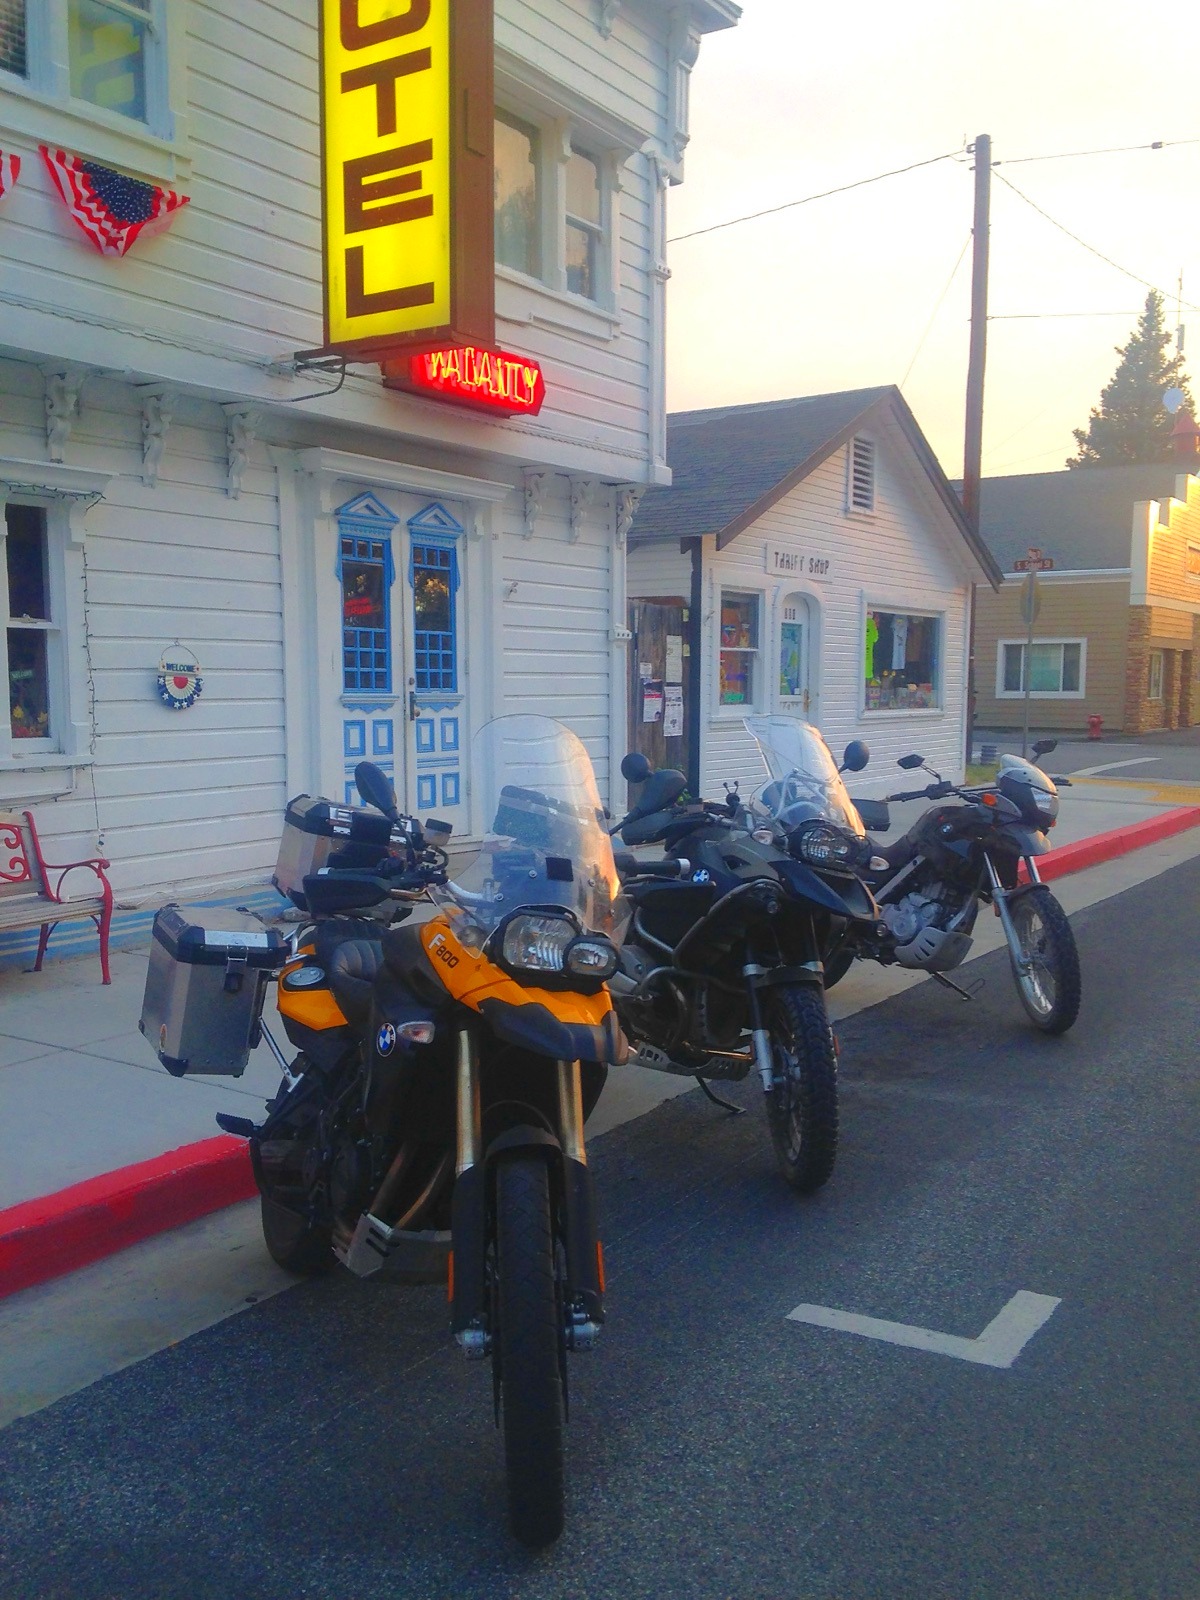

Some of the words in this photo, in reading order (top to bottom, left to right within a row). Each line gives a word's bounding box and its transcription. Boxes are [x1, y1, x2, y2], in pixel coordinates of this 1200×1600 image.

[428, 346, 539, 405] VACANCY
[808, 557, 830, 575] SHOP
[165, 662, 196, 673] WELCOME
[428, 932, 460, 969] F800
